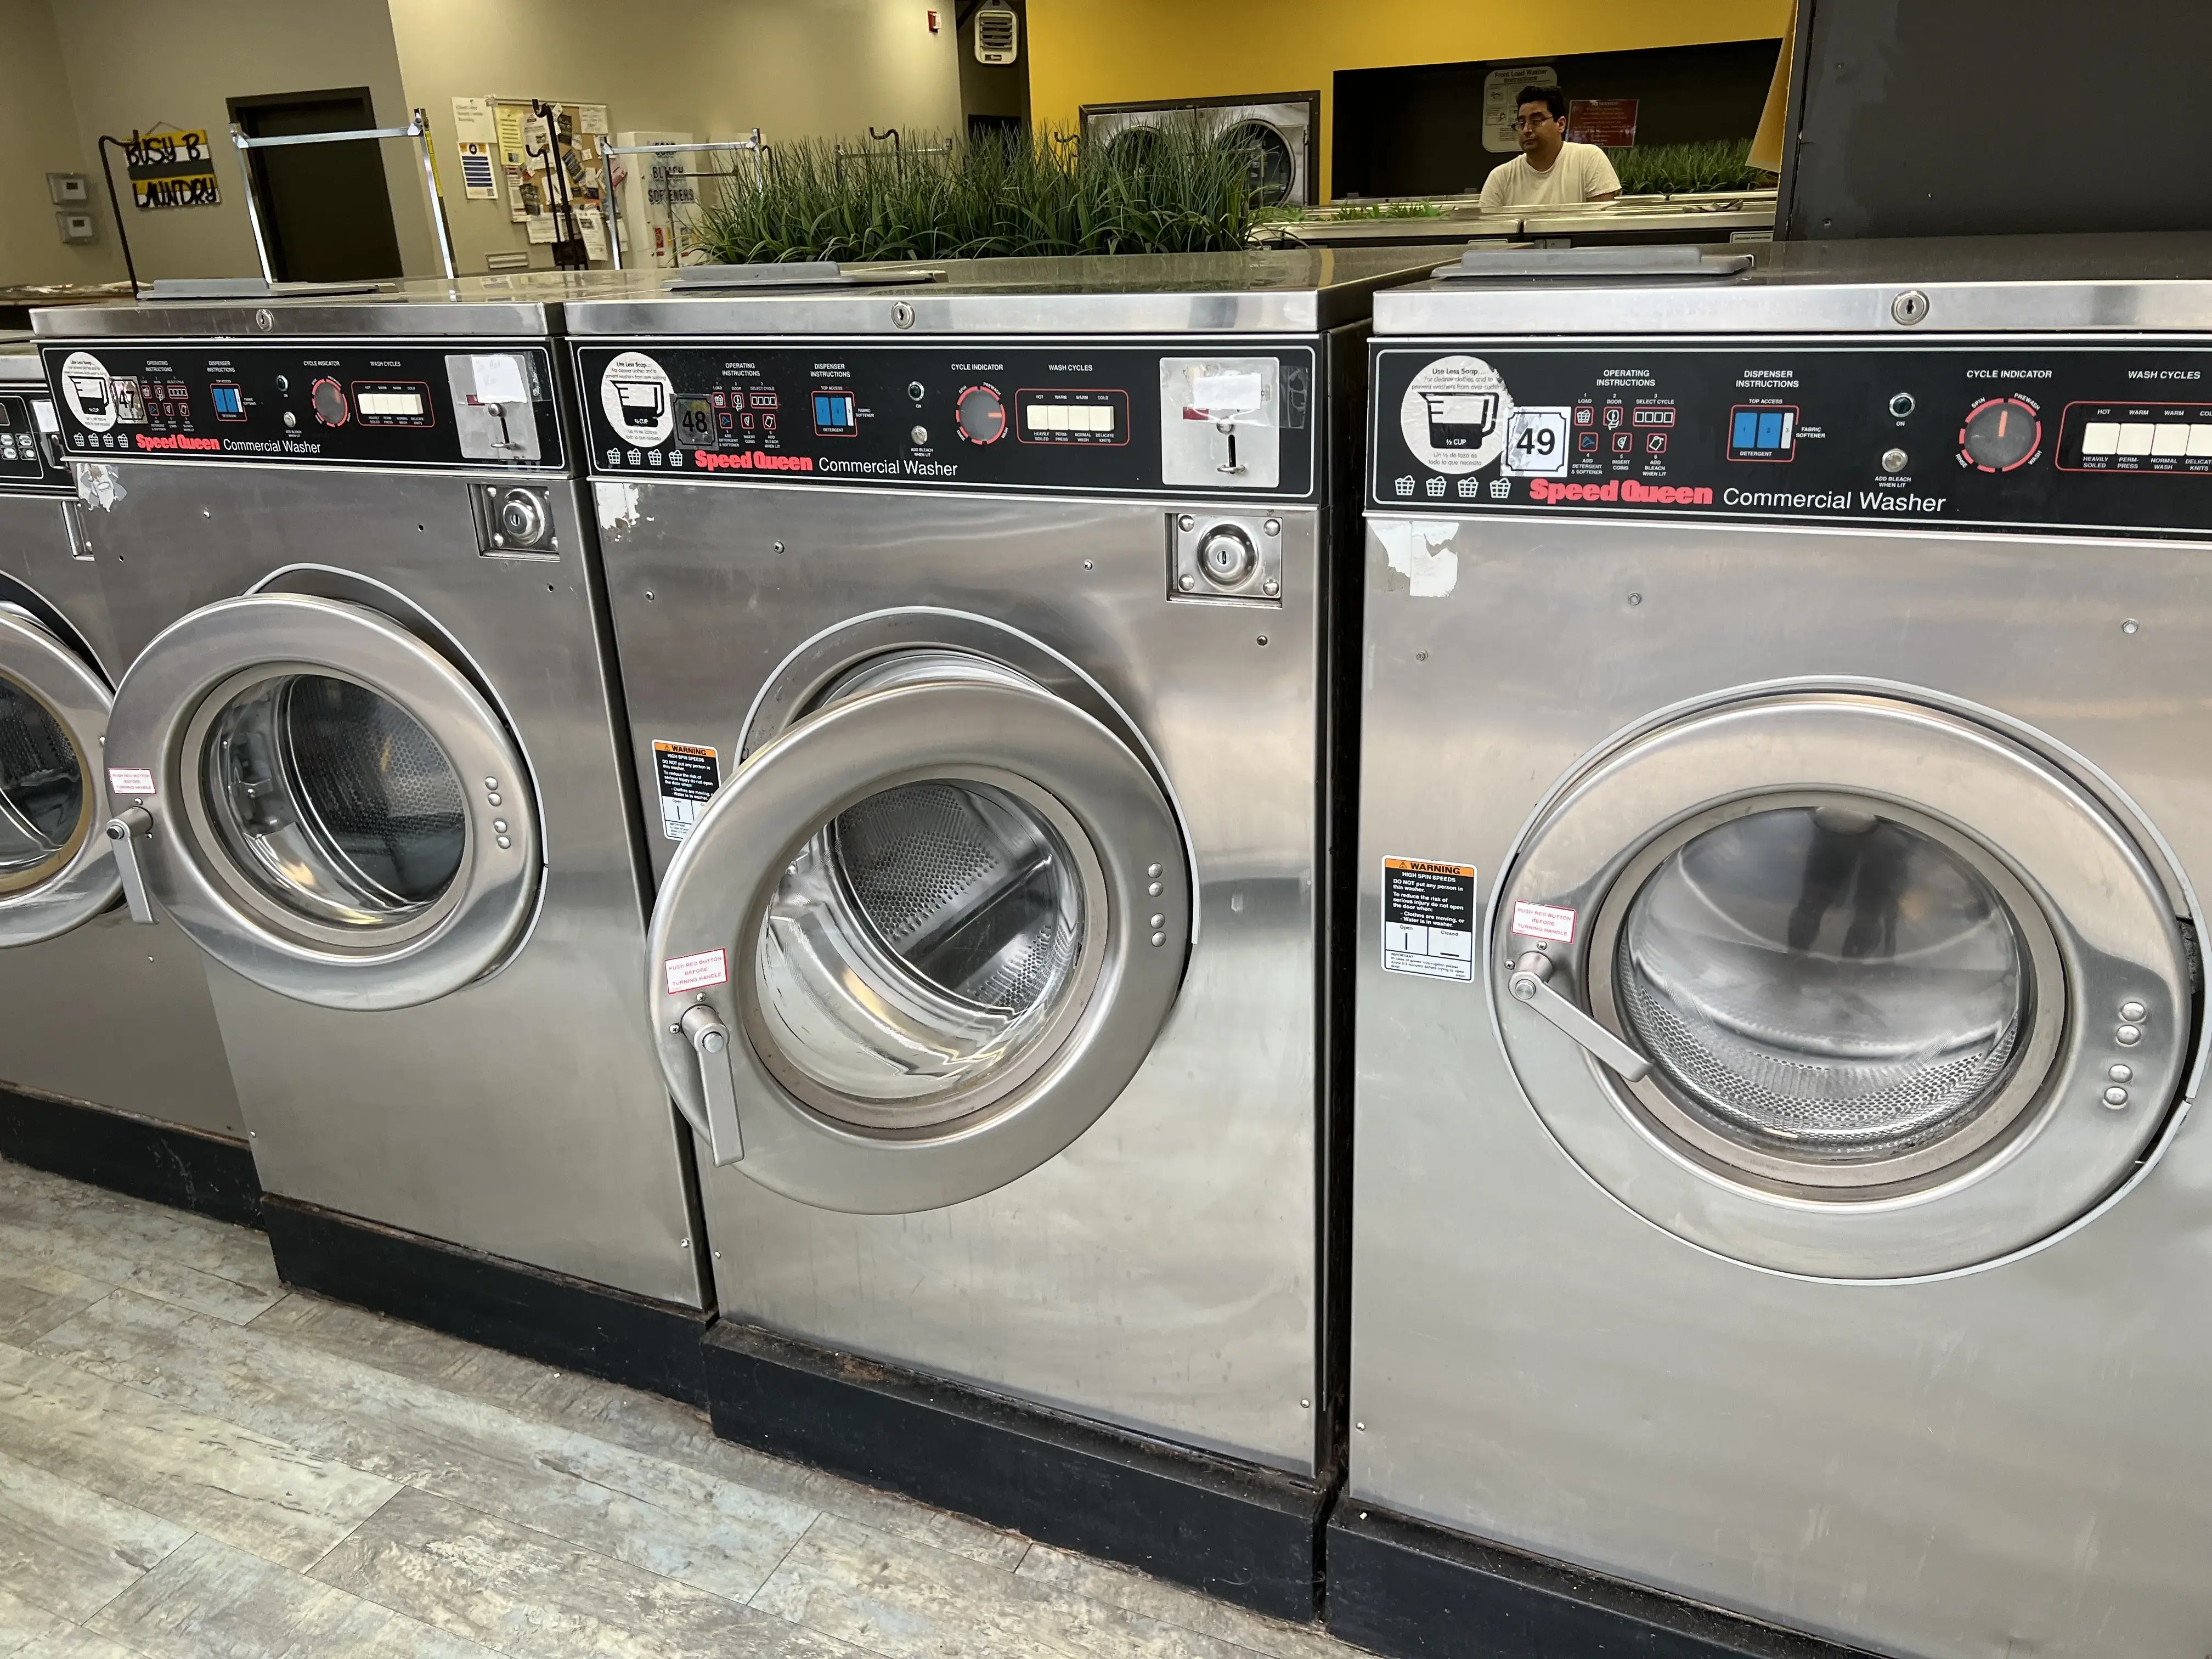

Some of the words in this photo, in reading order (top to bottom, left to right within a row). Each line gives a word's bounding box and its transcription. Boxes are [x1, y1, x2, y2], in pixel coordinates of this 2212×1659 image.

[182, 133, 200, 160] B
[133, 178, 216, 207] LAUNDRY
[648, 189, 694, 202] SOFENERS
[1967, 370, 1999, 378] CYCLE
[2001, 370, 2052, 379] INDICATOR
[983, 382, 1001, 396] PREWASH
[120, 391, 134, 408] 47
[1971, 397, 1986, 408] SPIN
[2014, 393, 2040, 411] PREWASH
[682, 410, 707, 433] 48
[136, 433, 178, 451] Speed
[177, 434, 220, 450] Queen
[223, 438, 281, 452] Commercial
[284, 440, 321, 454] Washer
[1517, 428, 1555, 455] 49
[695, 450, 752, 471] Speed
[754, 450, 812, 471] Queen
[819, 458, 899, 473] Commercial
[904, 460, 957, 476] Washer
[1955, 454, 1967, 468] RINSE
[2028, 450, 2042, 466] WASH
[1530, 479, 1620, 505] Speed
[1621, 479, 1713, 505] Queen
[1723, 487, 1850, 509] Commercial
[1860, 492, 1946, 512] Washer
[672, 746, 706, 755] WARNING
[1410, 862, 1460, 874] WARNING
[685, 967, 708, 975] BEFORE
[672, 978, 697, 986] TURNING
